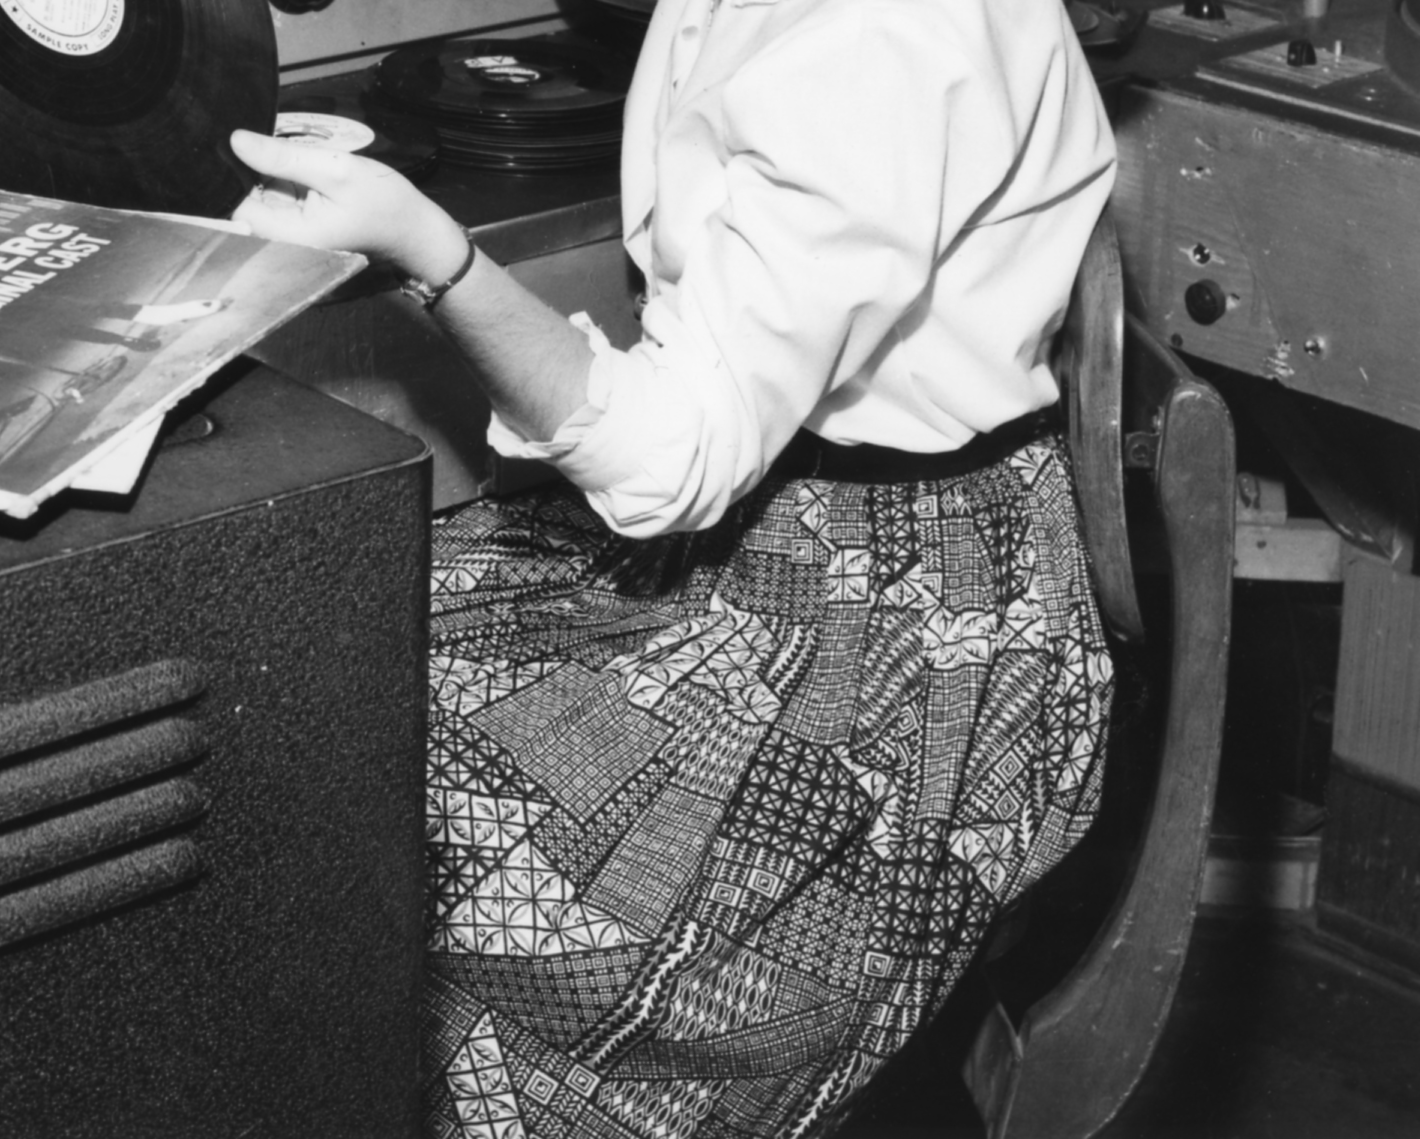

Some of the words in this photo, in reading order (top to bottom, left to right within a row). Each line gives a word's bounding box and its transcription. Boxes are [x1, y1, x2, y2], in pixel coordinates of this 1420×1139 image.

[27, 23, 62, 49] SAMPLE
[65, 42, 89, 52] COPY
[34, 233, 112, 269] CAST
